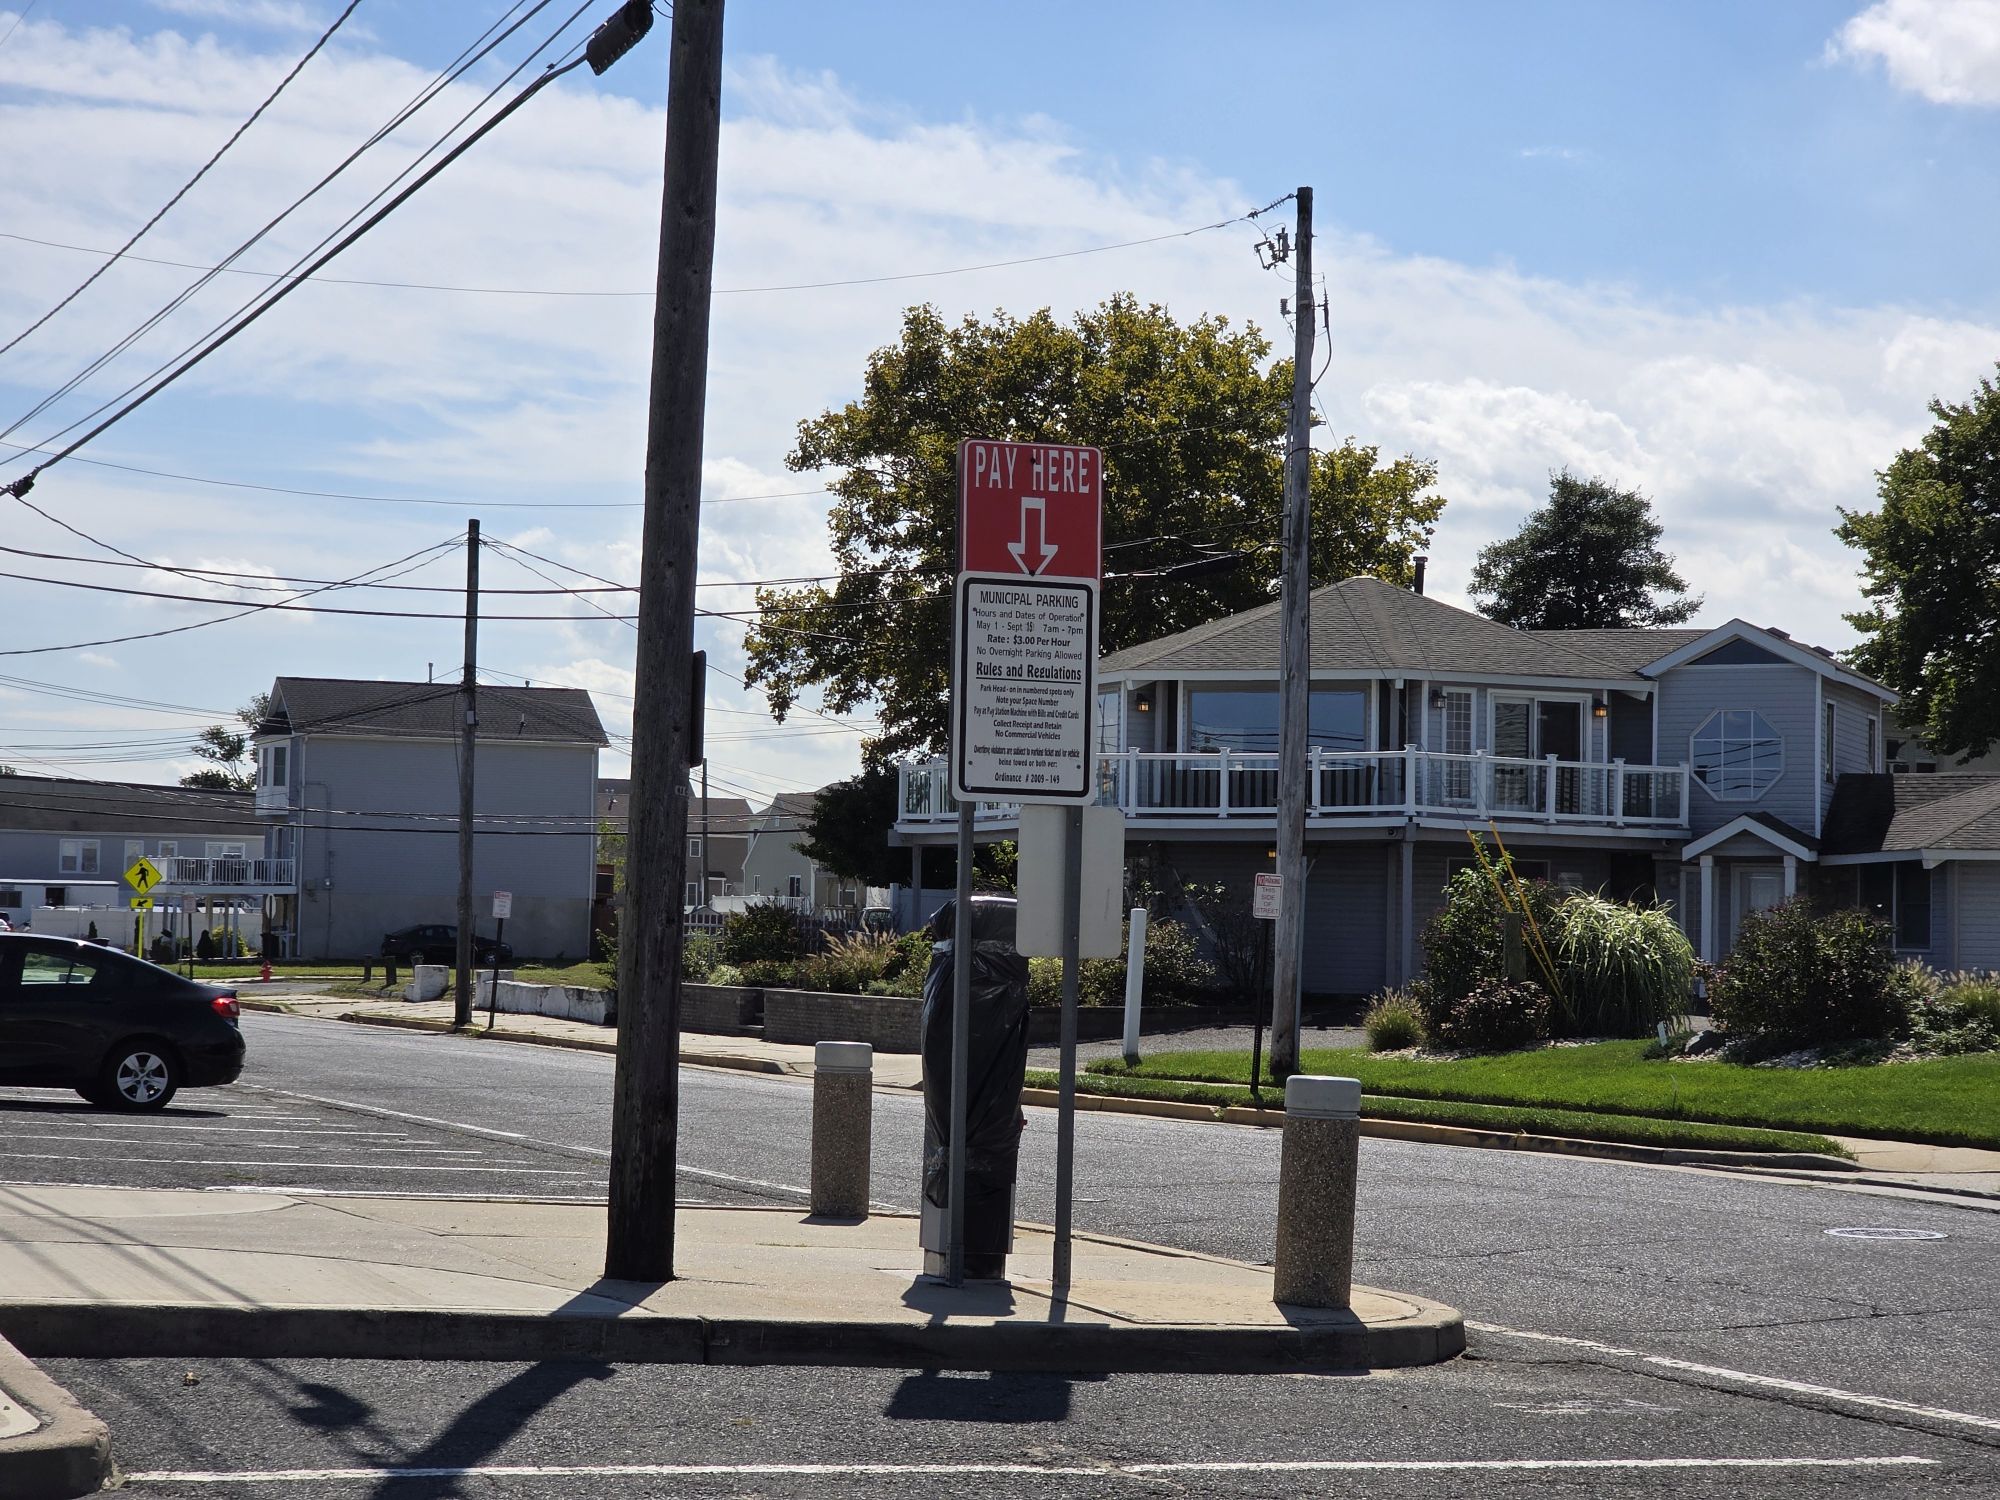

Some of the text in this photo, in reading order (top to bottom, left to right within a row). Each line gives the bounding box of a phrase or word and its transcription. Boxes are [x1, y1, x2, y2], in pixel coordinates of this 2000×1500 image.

[975, 445, 1090, 494] PAY HERE
[980, 591, 1079, 609] MUNICIPAL PARKING
[975, 608, 1082, 622] Hours and Dates of Operation
[976, 620, 991, 631] May
[995, 621, 998, 630] 1
[1007, 621, 1022, 632] Sept
[1042, 623, 1060, 633] 7am
[1067, 625, 1084, 636] 7pm
[1013, 634, 1035, 645] $3.00
[1036, 636, 1049, 646] Per
[1050, 637, 1071, 647] Hour
[976, 646, 1082, 660] No Overnight Parking Allowed
[976, 661, 1082, 680] Rules and Regulations
[980, 684, 991, 692] Park
[1022, 687, 1048, 695] numbered
[1063, 689, 1074, 698] only
[995, 695, 1059, 706] Note your Space Number
[993, 719, 1062, 730] Collect Receipt and Retain
[995, 729, 1061, 740] No Commercial Vehicles
[994, 771, 1022, 783] Ordinance
